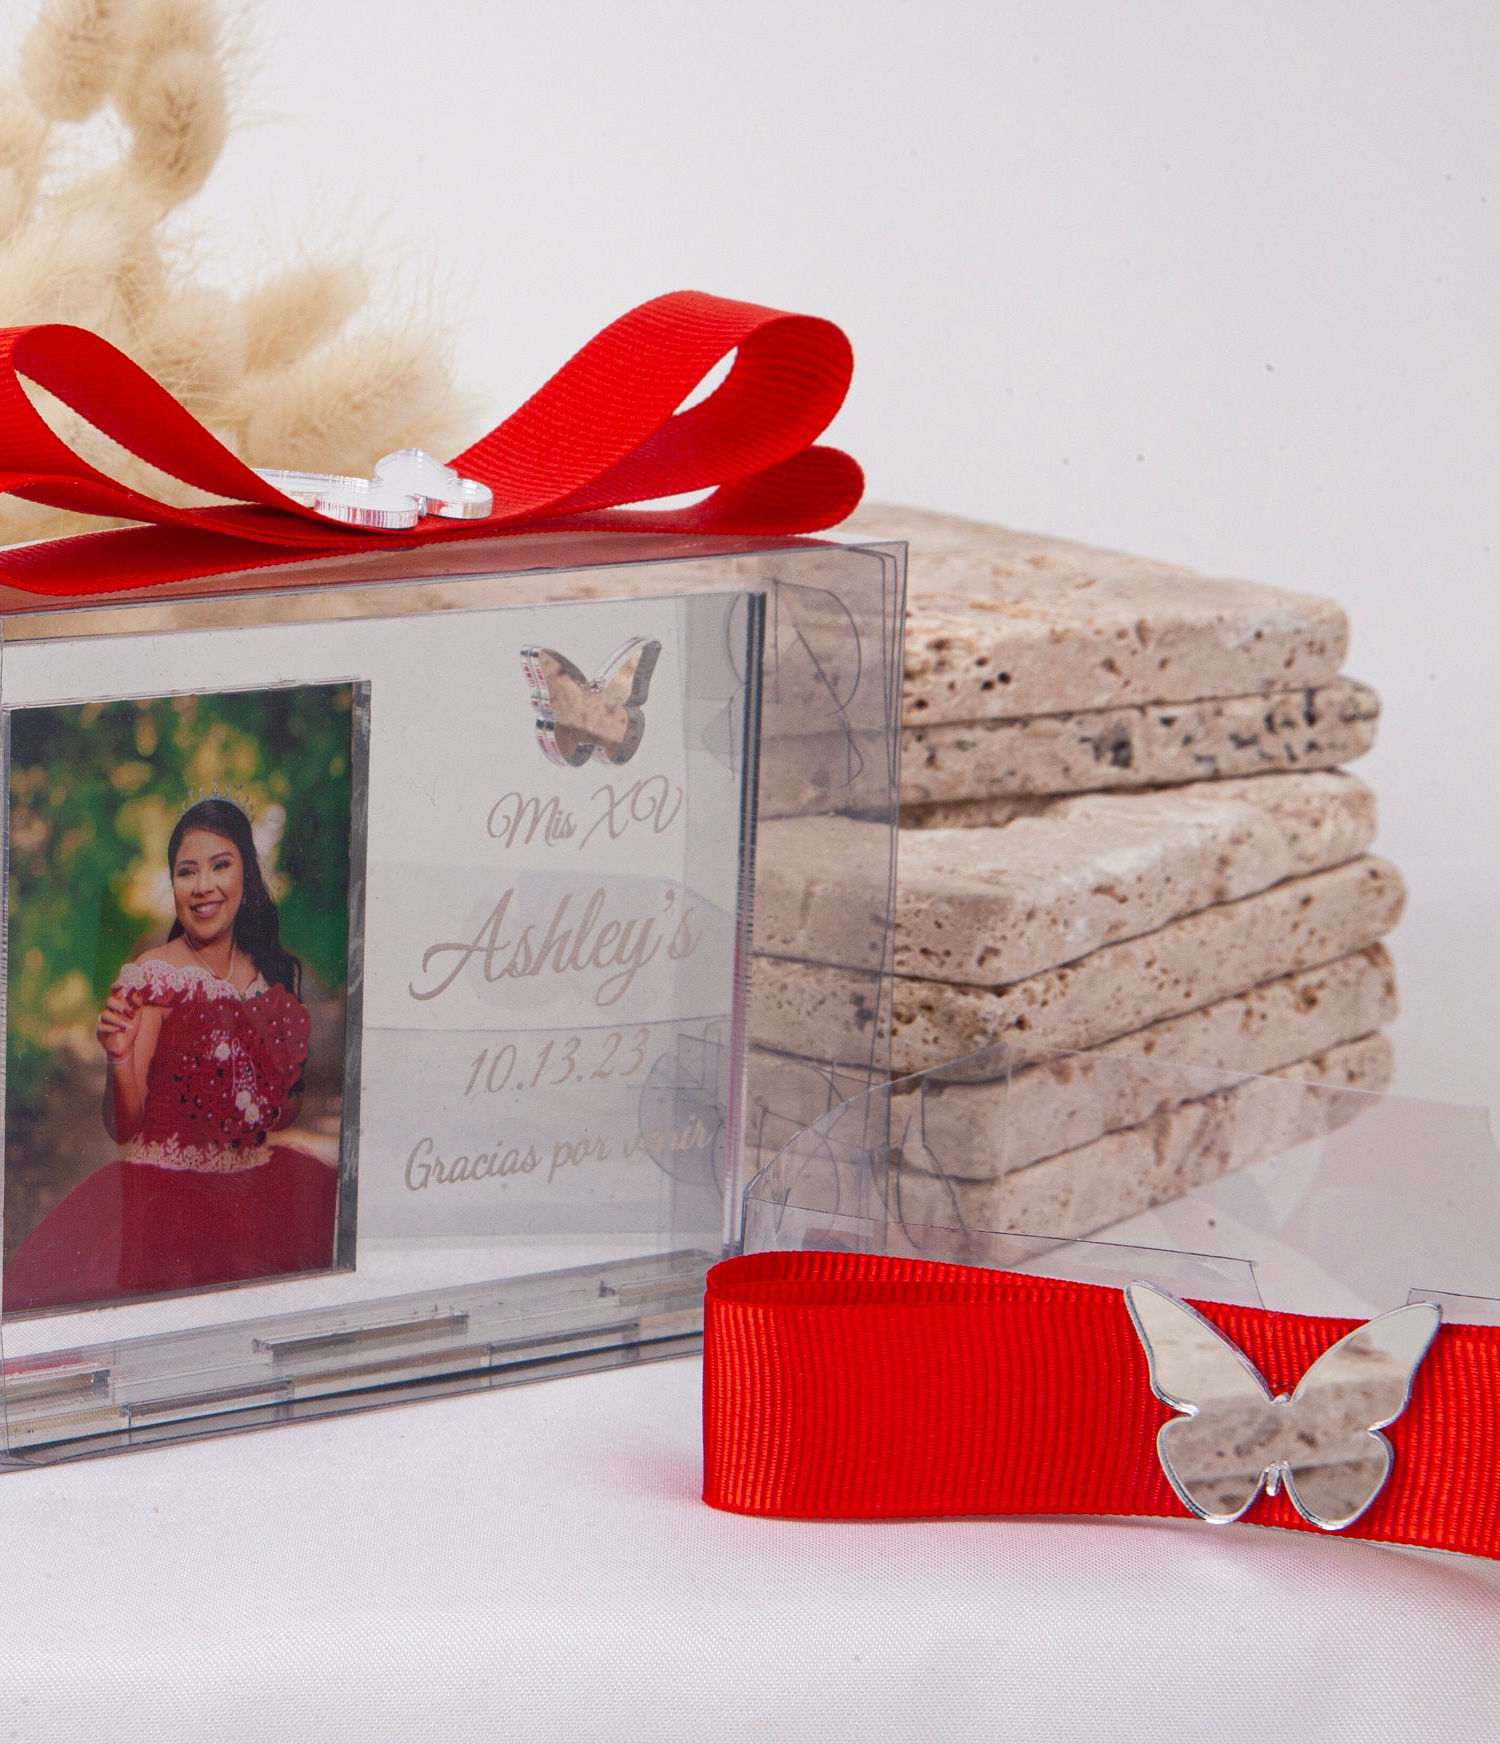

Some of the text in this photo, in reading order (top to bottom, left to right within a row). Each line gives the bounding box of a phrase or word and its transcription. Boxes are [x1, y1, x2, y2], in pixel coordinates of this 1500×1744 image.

[486, 774, 684, 851] Mis XV
[407, 888, 702, 1007] Ashley's
[464, 1027, 653, 1098] 10.13.23
[403, 1136, 543, 1192] Gracias
[547, 1135, 612, 1184] por
